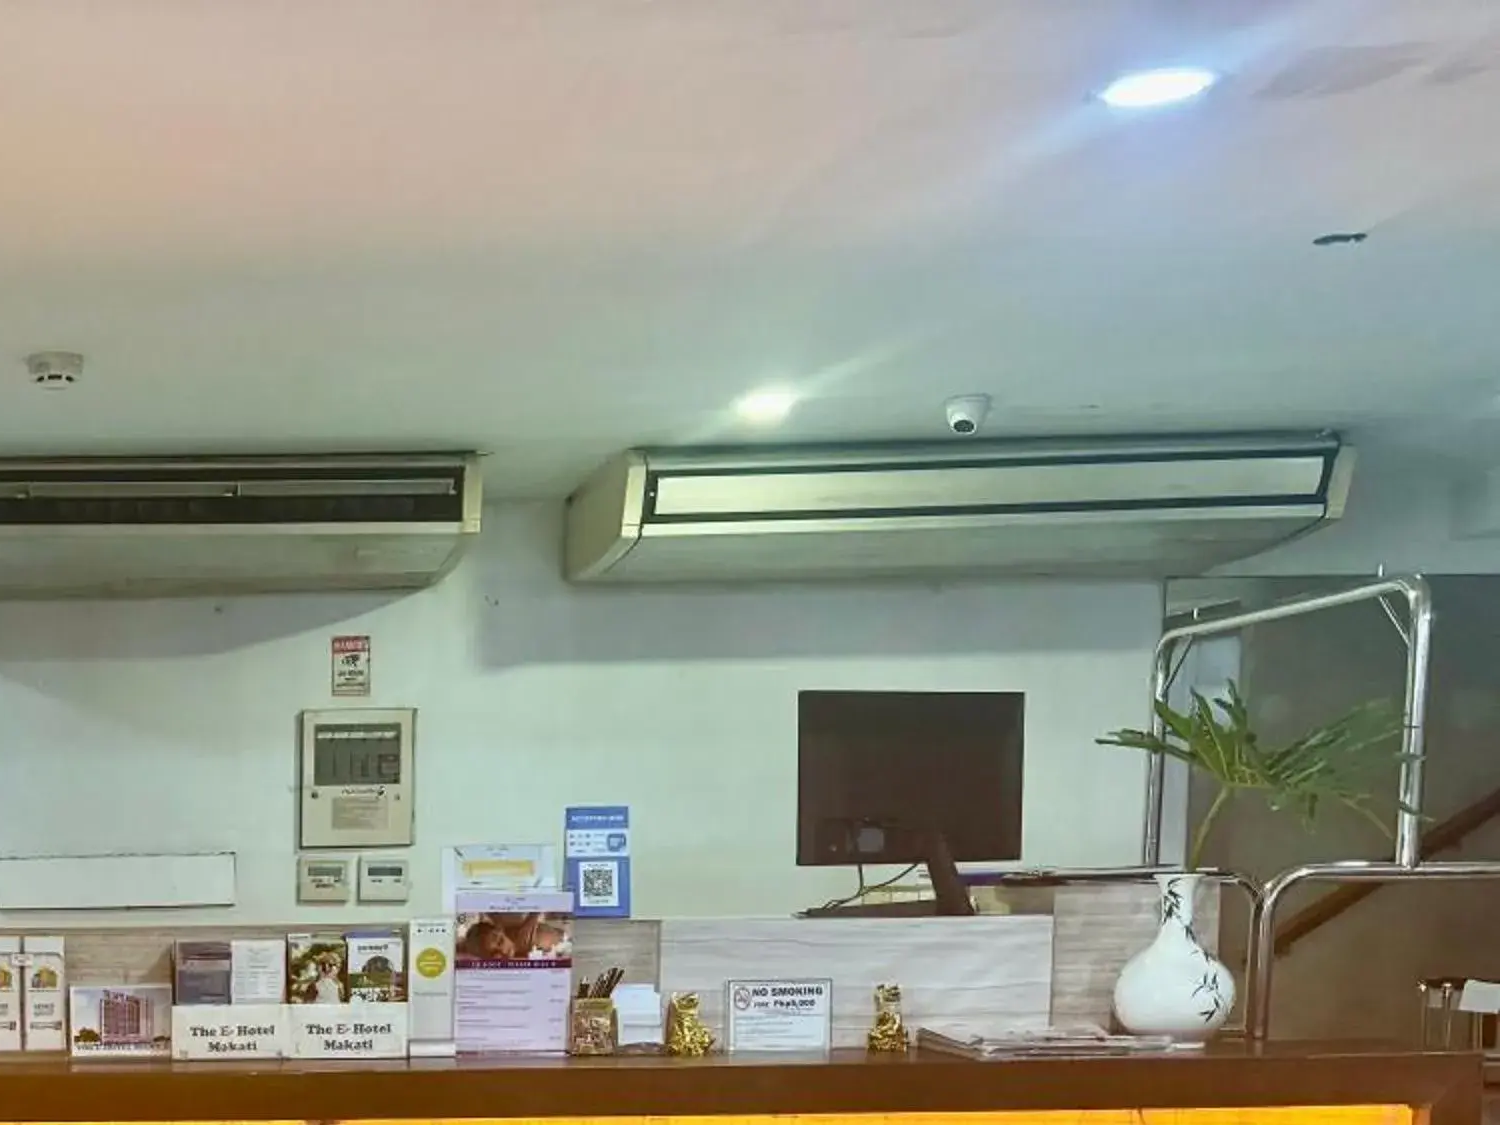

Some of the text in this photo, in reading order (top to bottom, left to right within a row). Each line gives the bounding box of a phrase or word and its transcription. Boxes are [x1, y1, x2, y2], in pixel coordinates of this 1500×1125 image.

[752, 986, 823, 997] NO SMOKING
[190, 1026, 217, 1037] The
[306, 1023, 333, 1035] The
[208, 1040, 258, 1052] Makati
[323, 1039, 373, 1051] Makati
